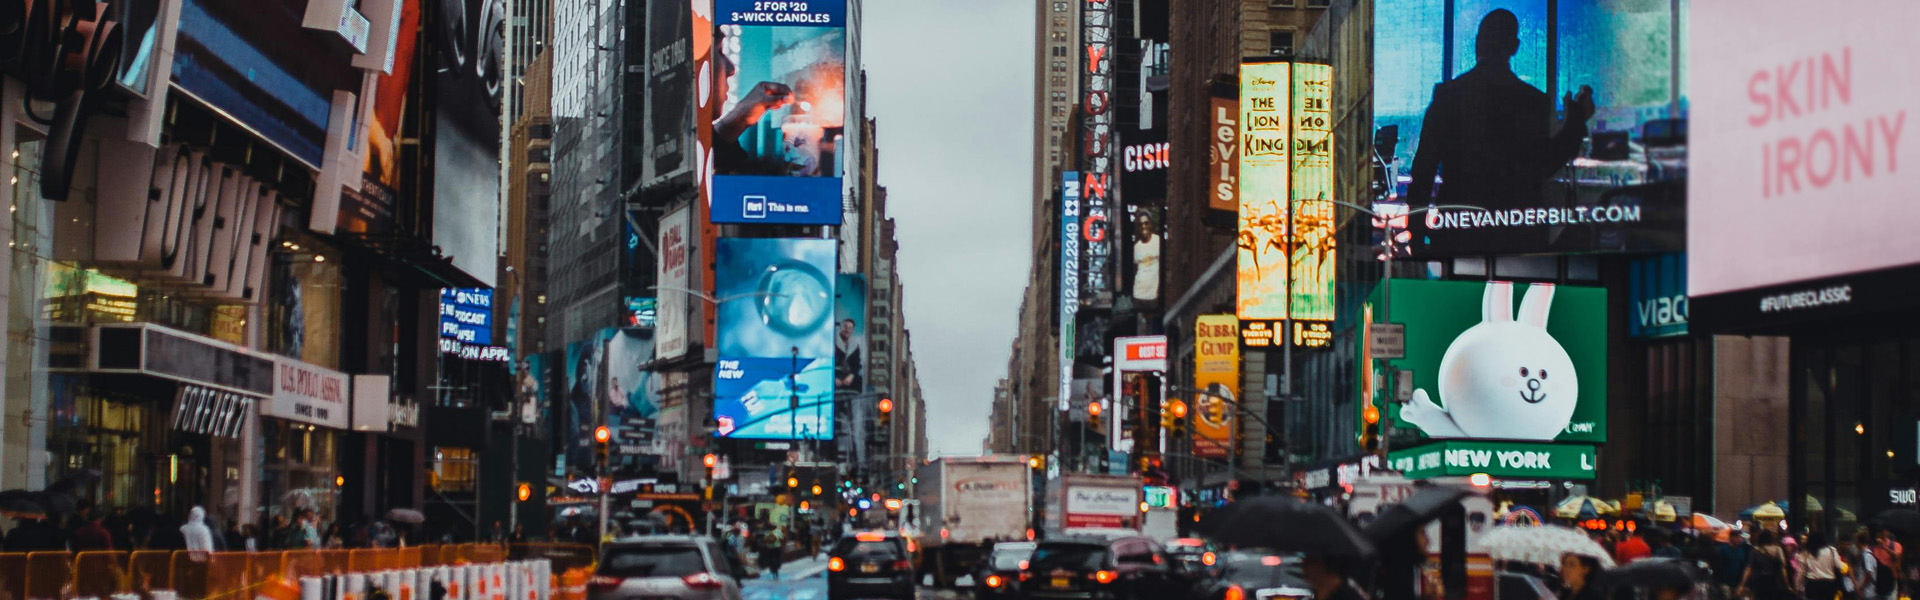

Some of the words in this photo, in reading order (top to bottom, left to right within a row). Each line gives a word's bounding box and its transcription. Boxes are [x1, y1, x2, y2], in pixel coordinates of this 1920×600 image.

[755, 2, 762, 11] 2
[764, 2, 788, 11] FOR
[789, 2, 808, 12] $20
[731, 12, 774, 22] 3-WICK
[775, 13, 830, 23] CANDLES
[652, 45, 670, 76] SINCE
[1747, 46, 1851, 128] SKIN
[1251, 97, 1275, 109] THE
[1246, 112, 1279, 131] LION
[1244, 134, 1284, 157] KING
[1762, 109, 1906, 200] IRONY
[768, 203, 785, 212] This
[786, 204, 793, 212] is
[1427, 205, 1641, 229] ONEVANDERBILT.COM
[1064, 222, 1080, 314] 212.372.2349
[1760, 287, 1851, 312] #FUTURECLASSIC
[462, 345, 479, 359] ON
[718, 370, 744, 379] NEW
[719, 359, 739, 370] THE
[1444, 449, 1491, 468] NEW
[1496, 450, 1550, 470] YORK
